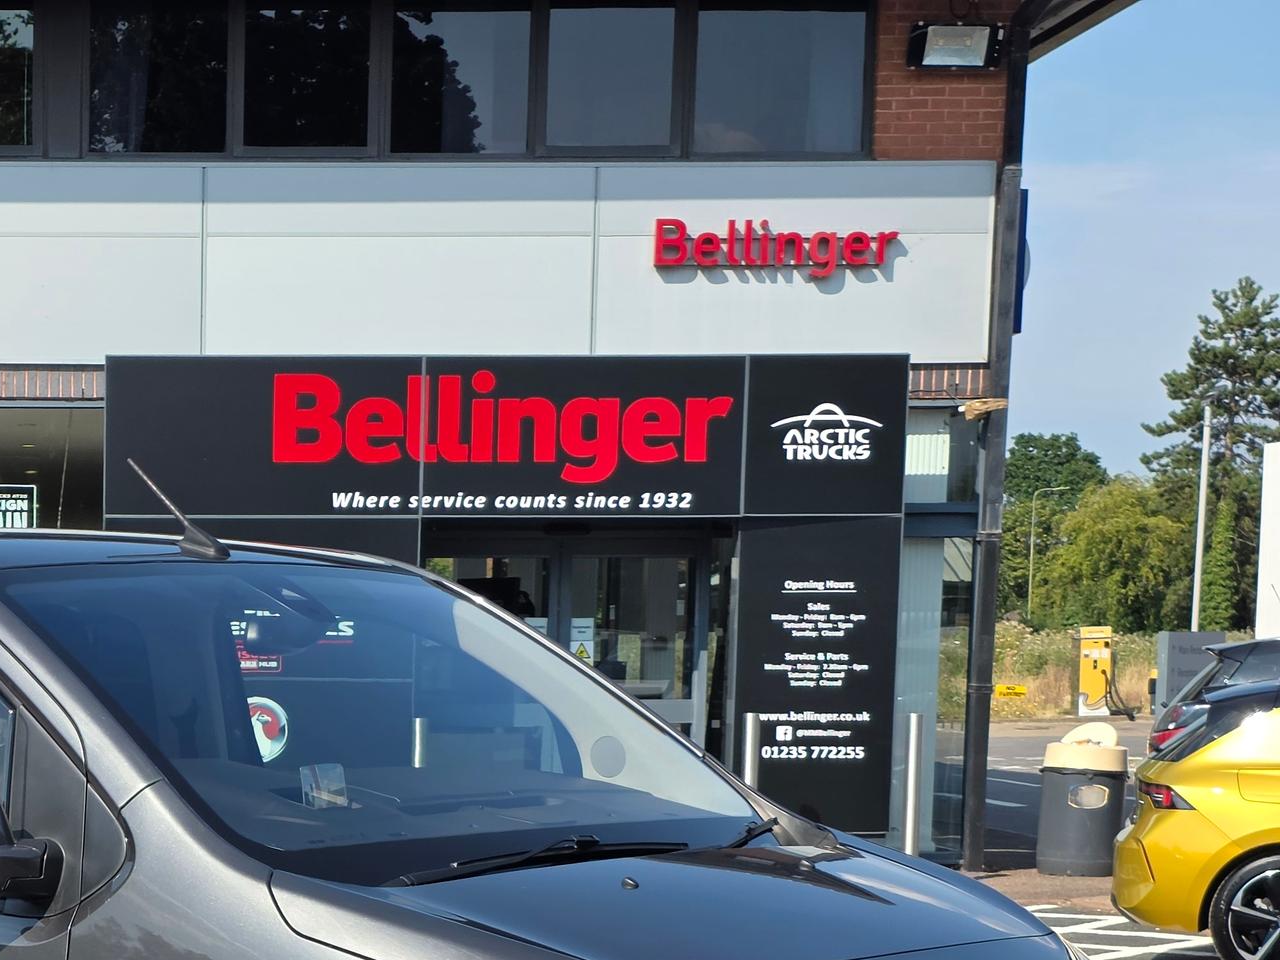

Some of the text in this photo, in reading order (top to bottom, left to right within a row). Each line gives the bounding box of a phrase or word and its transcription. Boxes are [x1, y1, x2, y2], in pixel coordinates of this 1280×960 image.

[653, 218, 900, 278] Bellinger
[272, 370, 734, 485] Bellinger
[782, 428, 871, 444] ARCTIC
[782, 444, 871, 460] TRUCKS
[332, 491, 693, 509] Where service counts since 1932
[784, 580, 855, 590] Opening Hours
[807, 602, 831, 611] Sales
[785, 652, 849, 661] Service & Parts
[759, 711, 871, 723] www.bellinger.co.uk
[761, 745, 865, 759] 01235 772255
